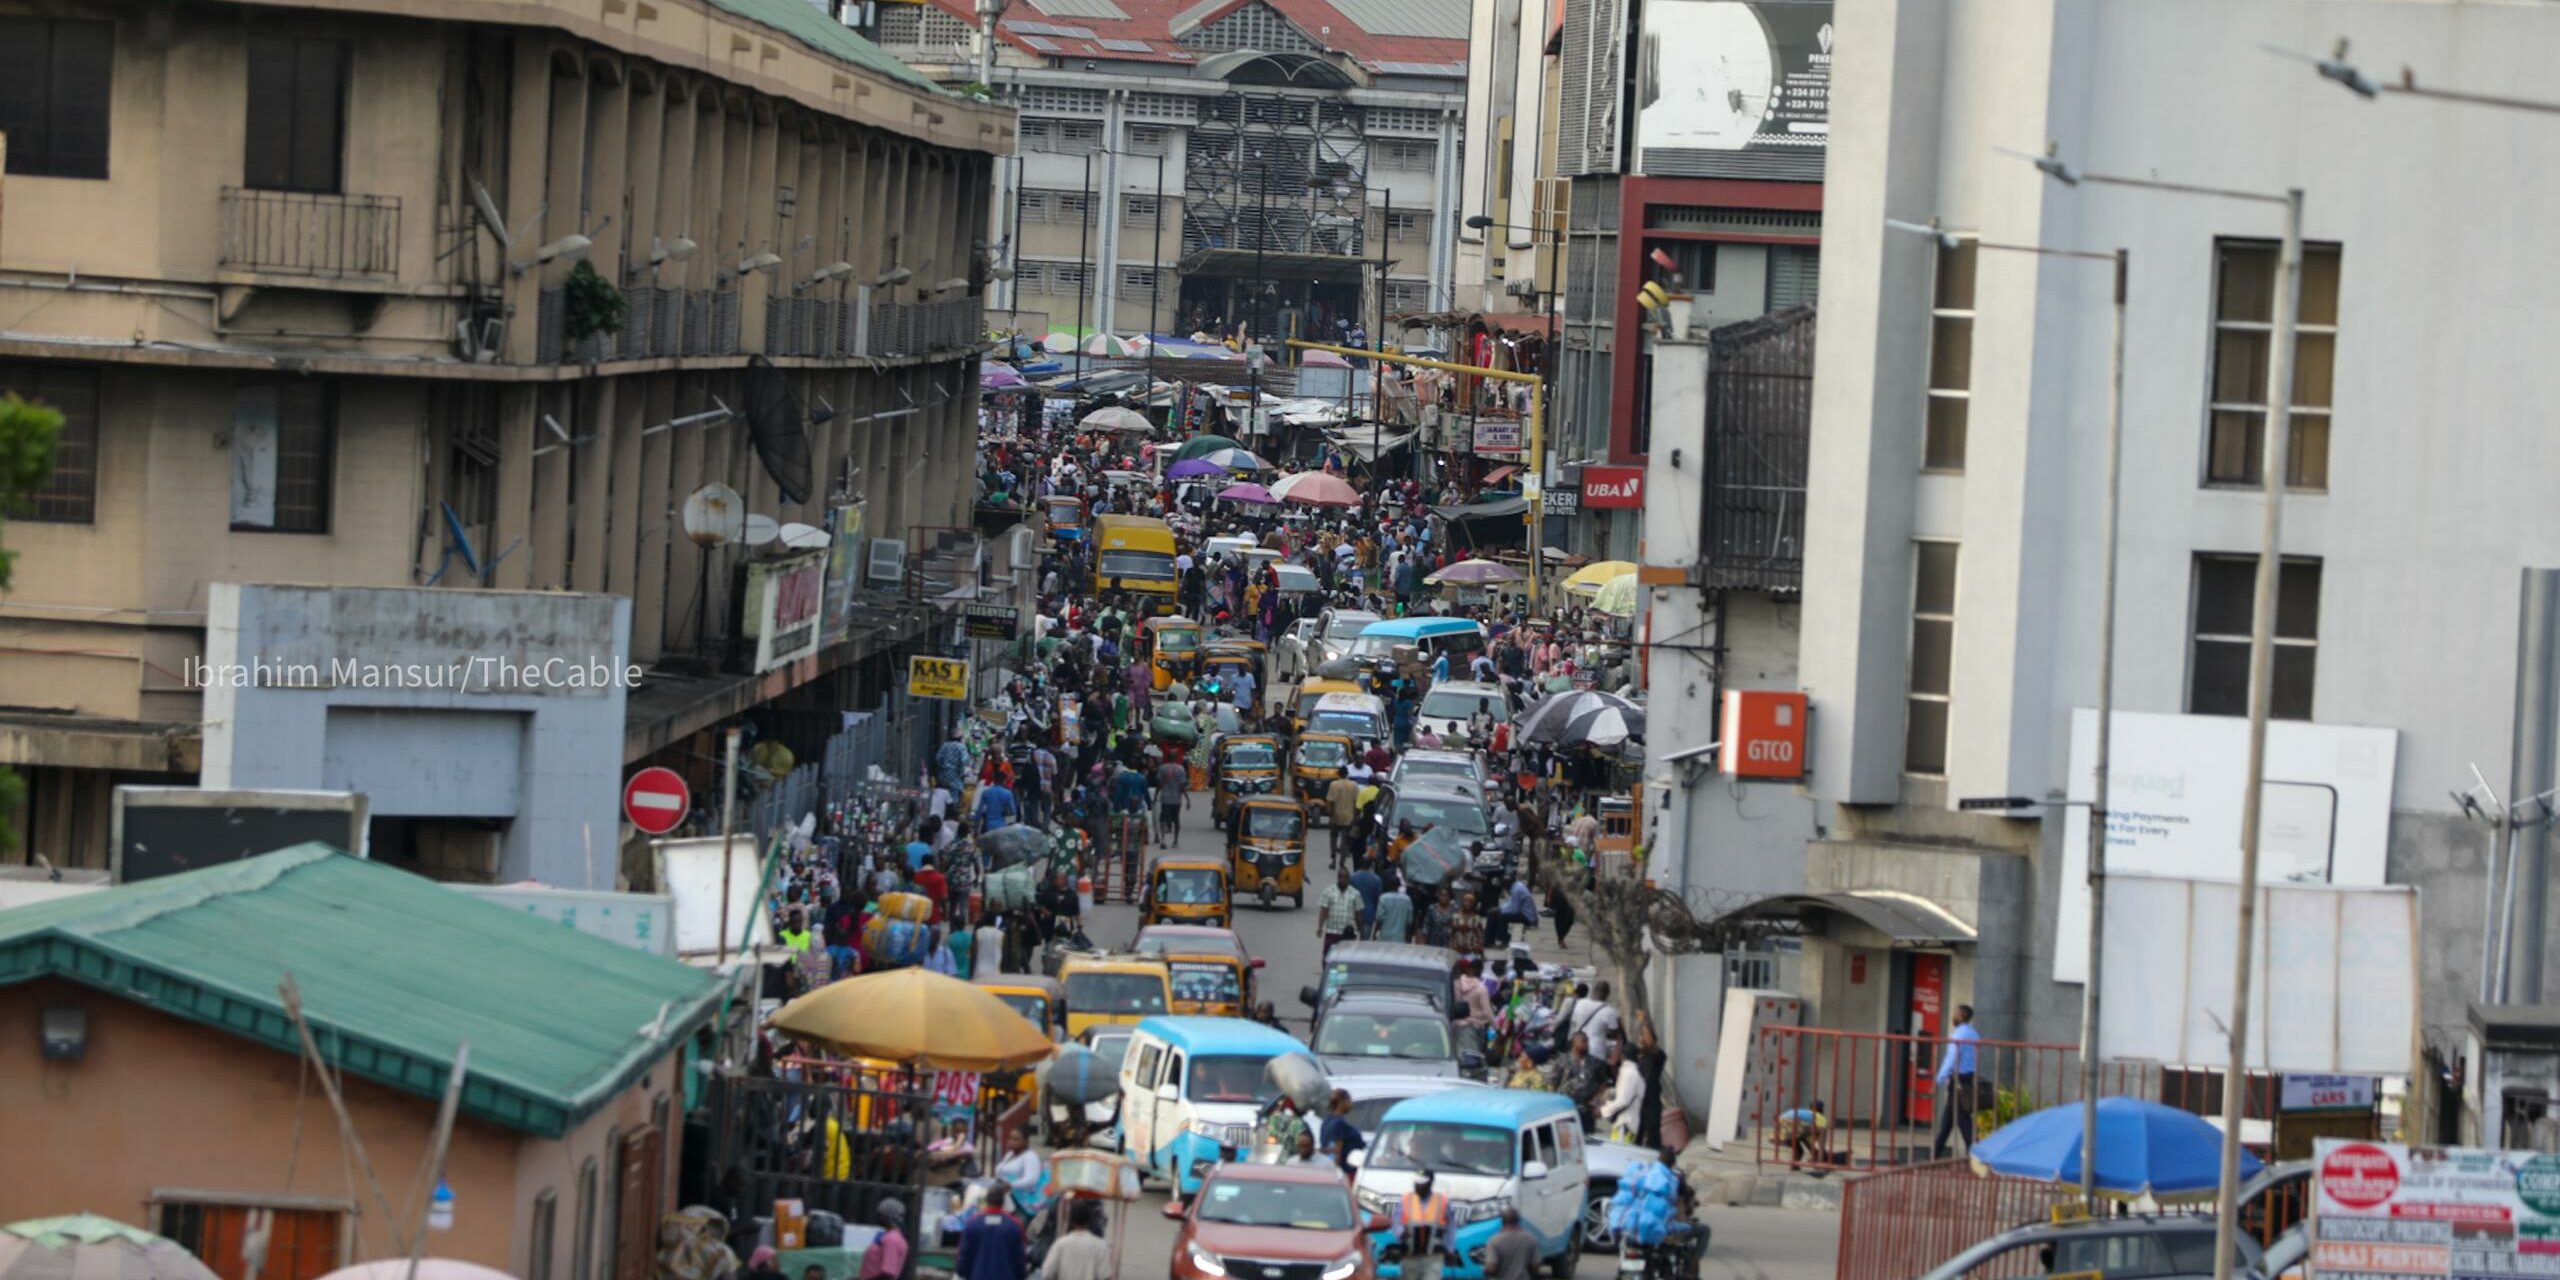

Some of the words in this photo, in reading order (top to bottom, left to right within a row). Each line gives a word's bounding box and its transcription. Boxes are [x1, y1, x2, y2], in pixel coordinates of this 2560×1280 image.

[1587, 483, 1620, 496] UBA
[1543, 491, 1577, 507] EKERI
[912, 660, 952, 682] KAS
[1747, 738, 1793, 762] GTCO
[2133, 811, 2190, 824] Payments
[2120, 824, 2137, 833] For
[2139, 826, 2168, 839] Every
[933, 1071, 977, 1105] POS
[2310, 1090, 2347, 1106] CARS
